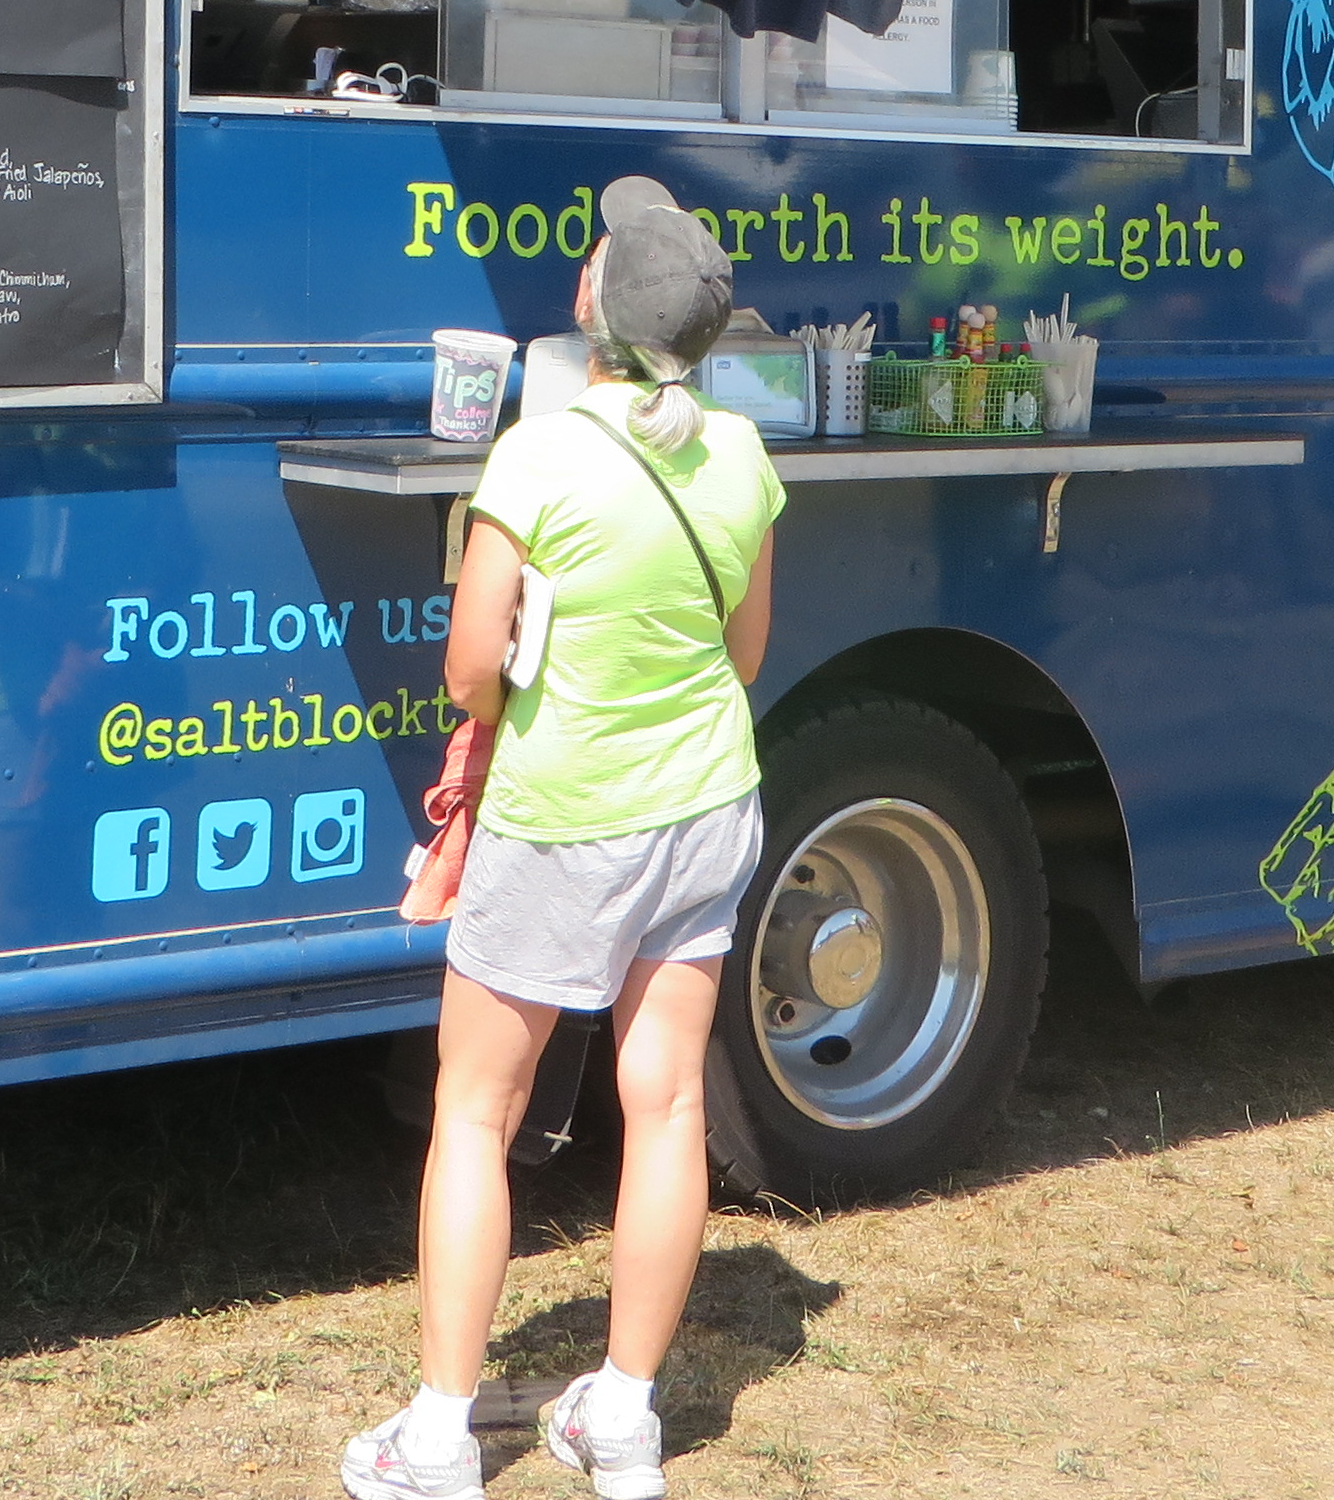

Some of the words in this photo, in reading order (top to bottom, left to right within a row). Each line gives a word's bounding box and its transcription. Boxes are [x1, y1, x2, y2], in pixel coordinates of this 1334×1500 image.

[873, 33, 910, 42] LERGY.
[918, 16, 940, 26] FOOD
[3, 183, 33, 201] Aioli
[403, 182, 593, 259] Food
[690, 193, 854, 262] rth
[880, 196, 980, 265] its
[1005, 202, 1245, 281] weight.
[435, 355, 497, 408] Tips
[103, 590, 354, 663] Follow
[378, 595, 451, 645] us
[99, 693, 457, 766] @saltblockt
